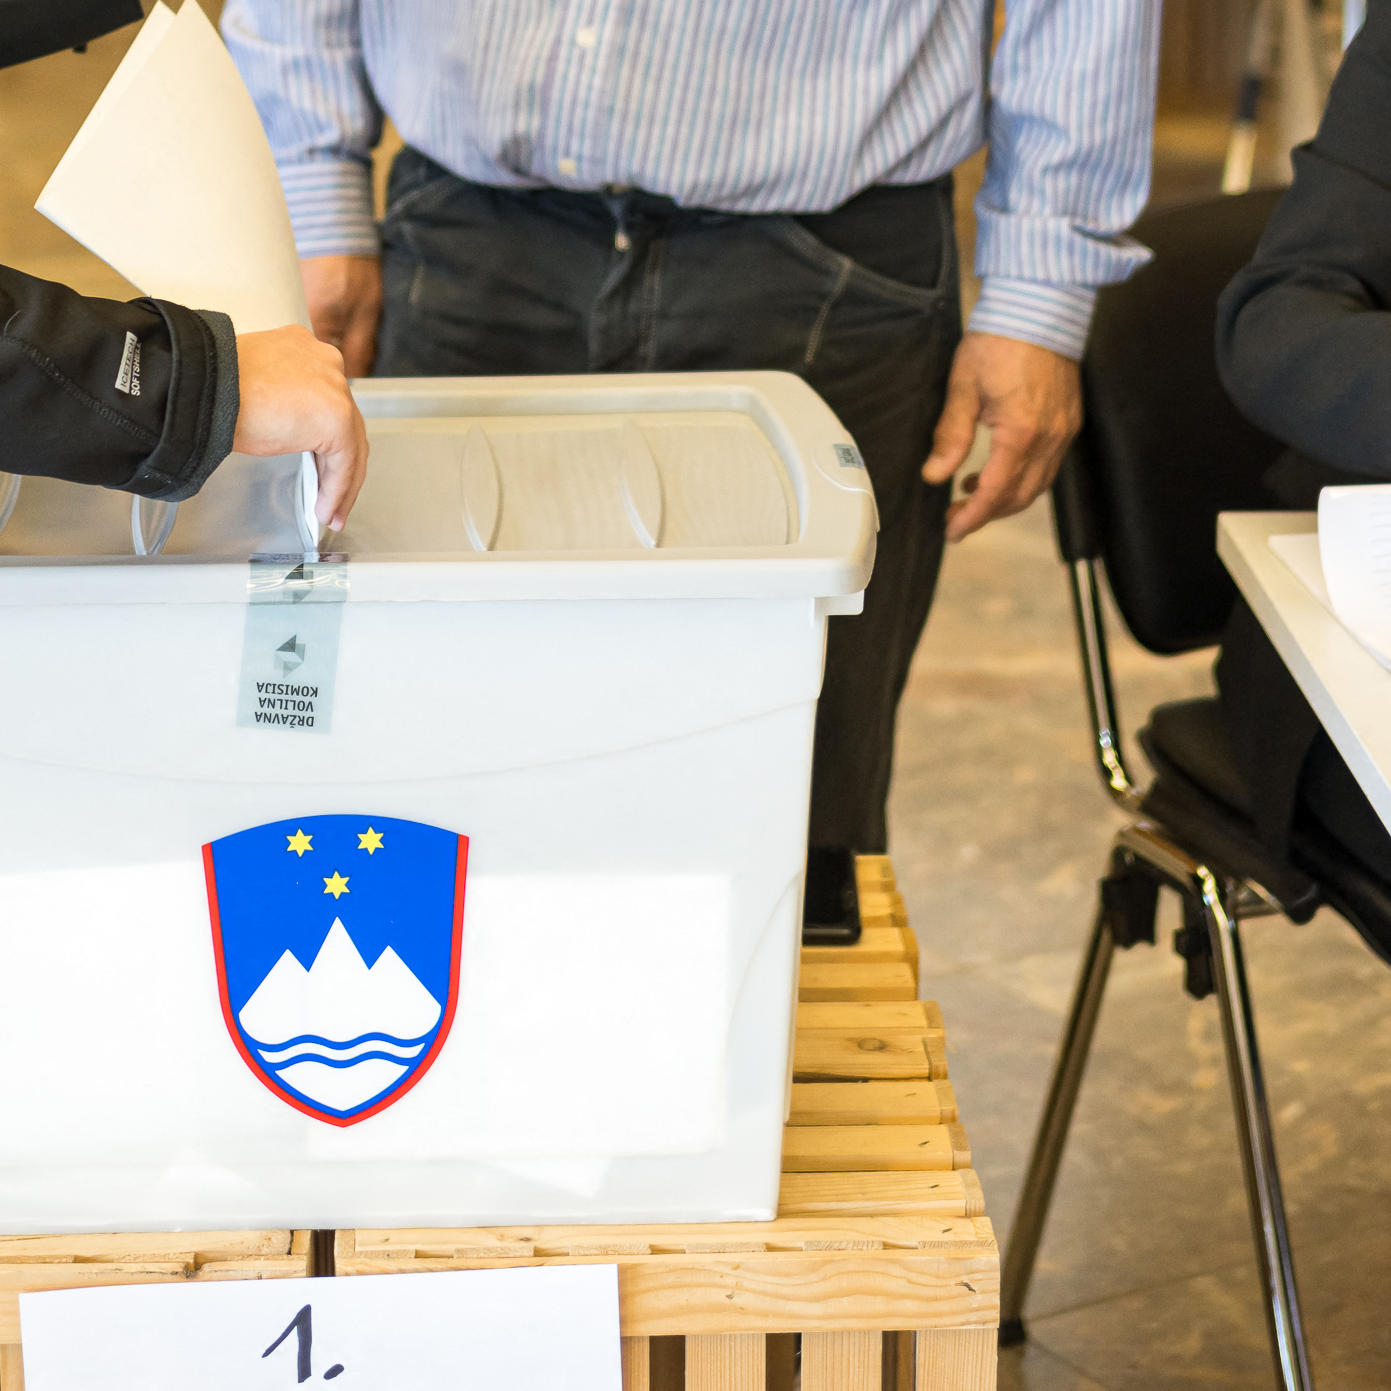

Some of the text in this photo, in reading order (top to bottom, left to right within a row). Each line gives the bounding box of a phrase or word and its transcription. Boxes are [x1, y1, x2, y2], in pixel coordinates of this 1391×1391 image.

[120, 337, 135, 388] ICETECH
[256, 681, 319, 698] KOMISIJA
[258, 696, 314, 712] VOLILNA
[254, 711, 315, 729] DRŽAVNA
[260, 1303, 346, 1385] 1.
